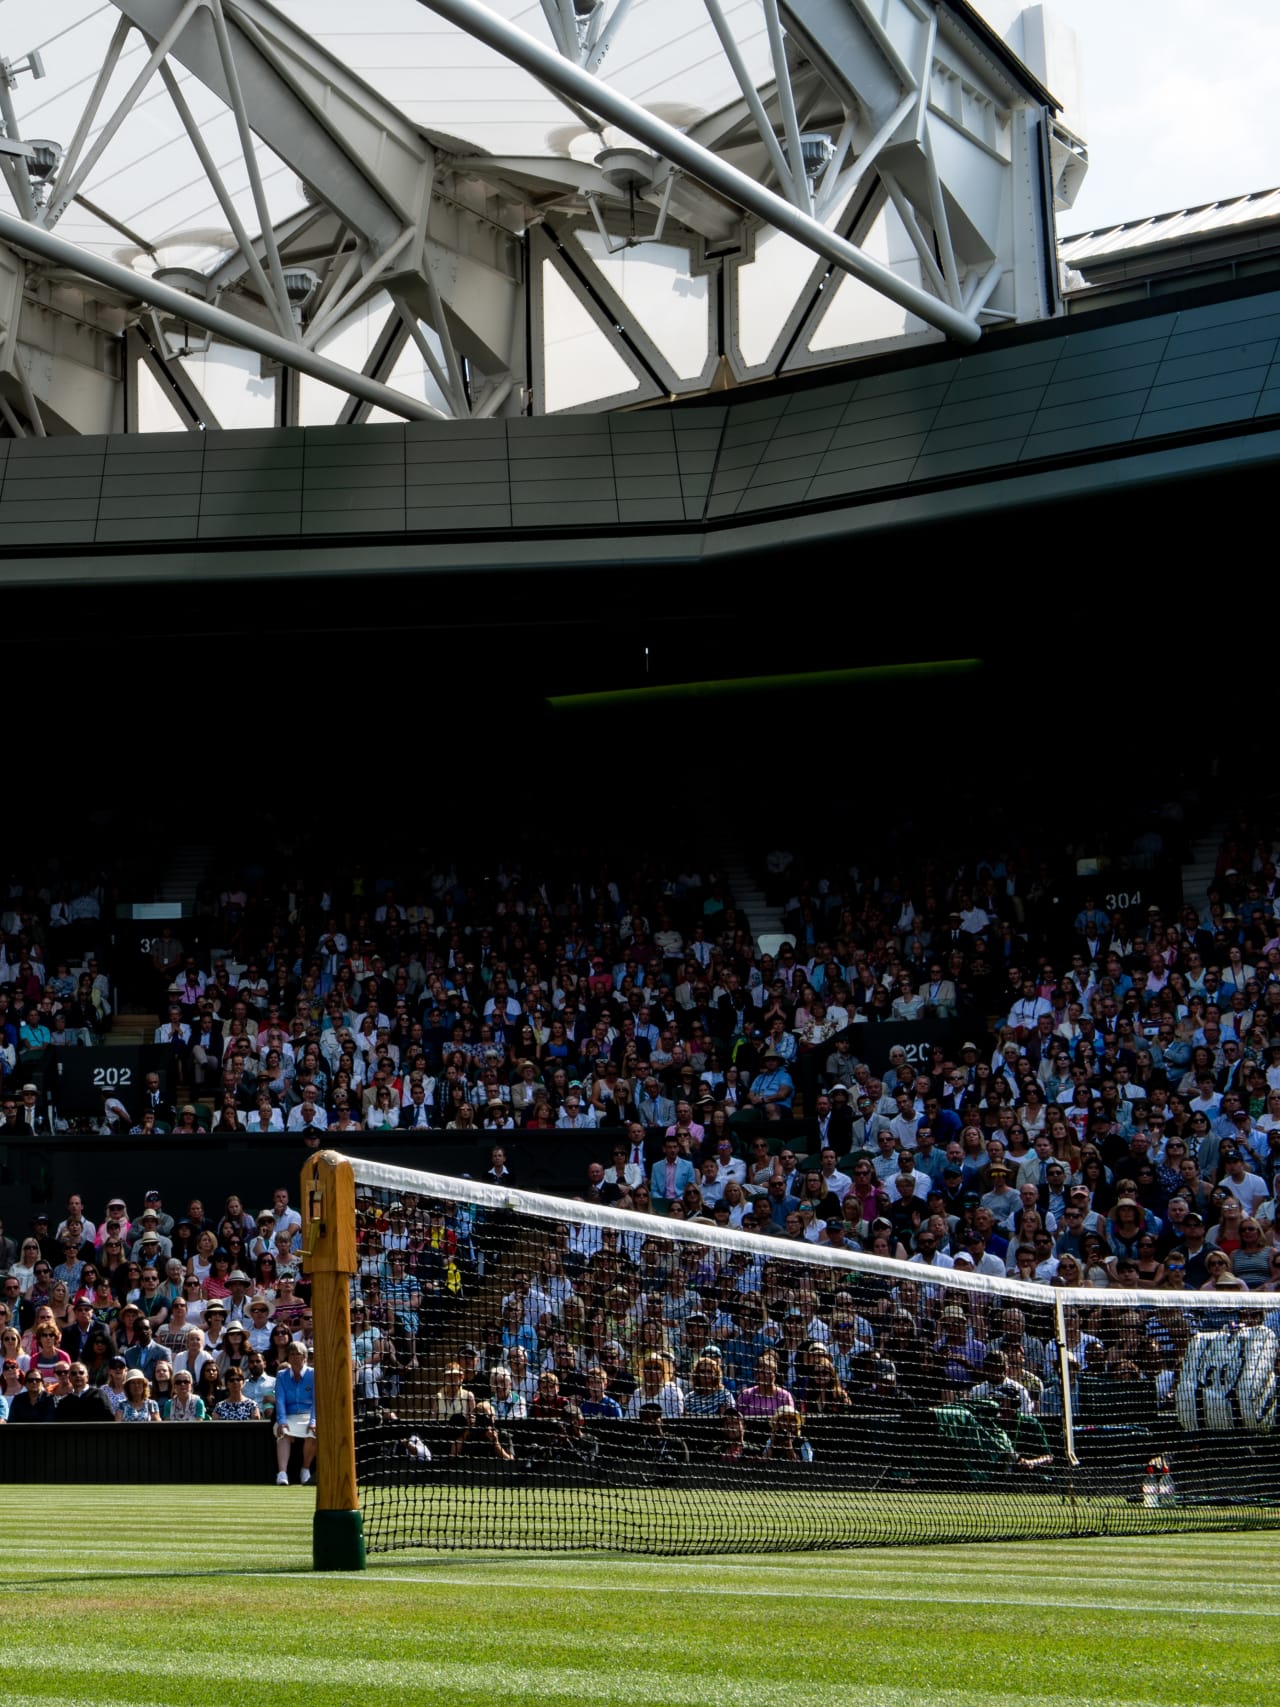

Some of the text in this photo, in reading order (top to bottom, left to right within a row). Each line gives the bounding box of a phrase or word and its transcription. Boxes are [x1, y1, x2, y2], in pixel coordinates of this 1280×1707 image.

[1105, 891, 1141, 910] 304
[905, 1043, 931, 1062] 20
[93, 1067, 131, 1085] 202
